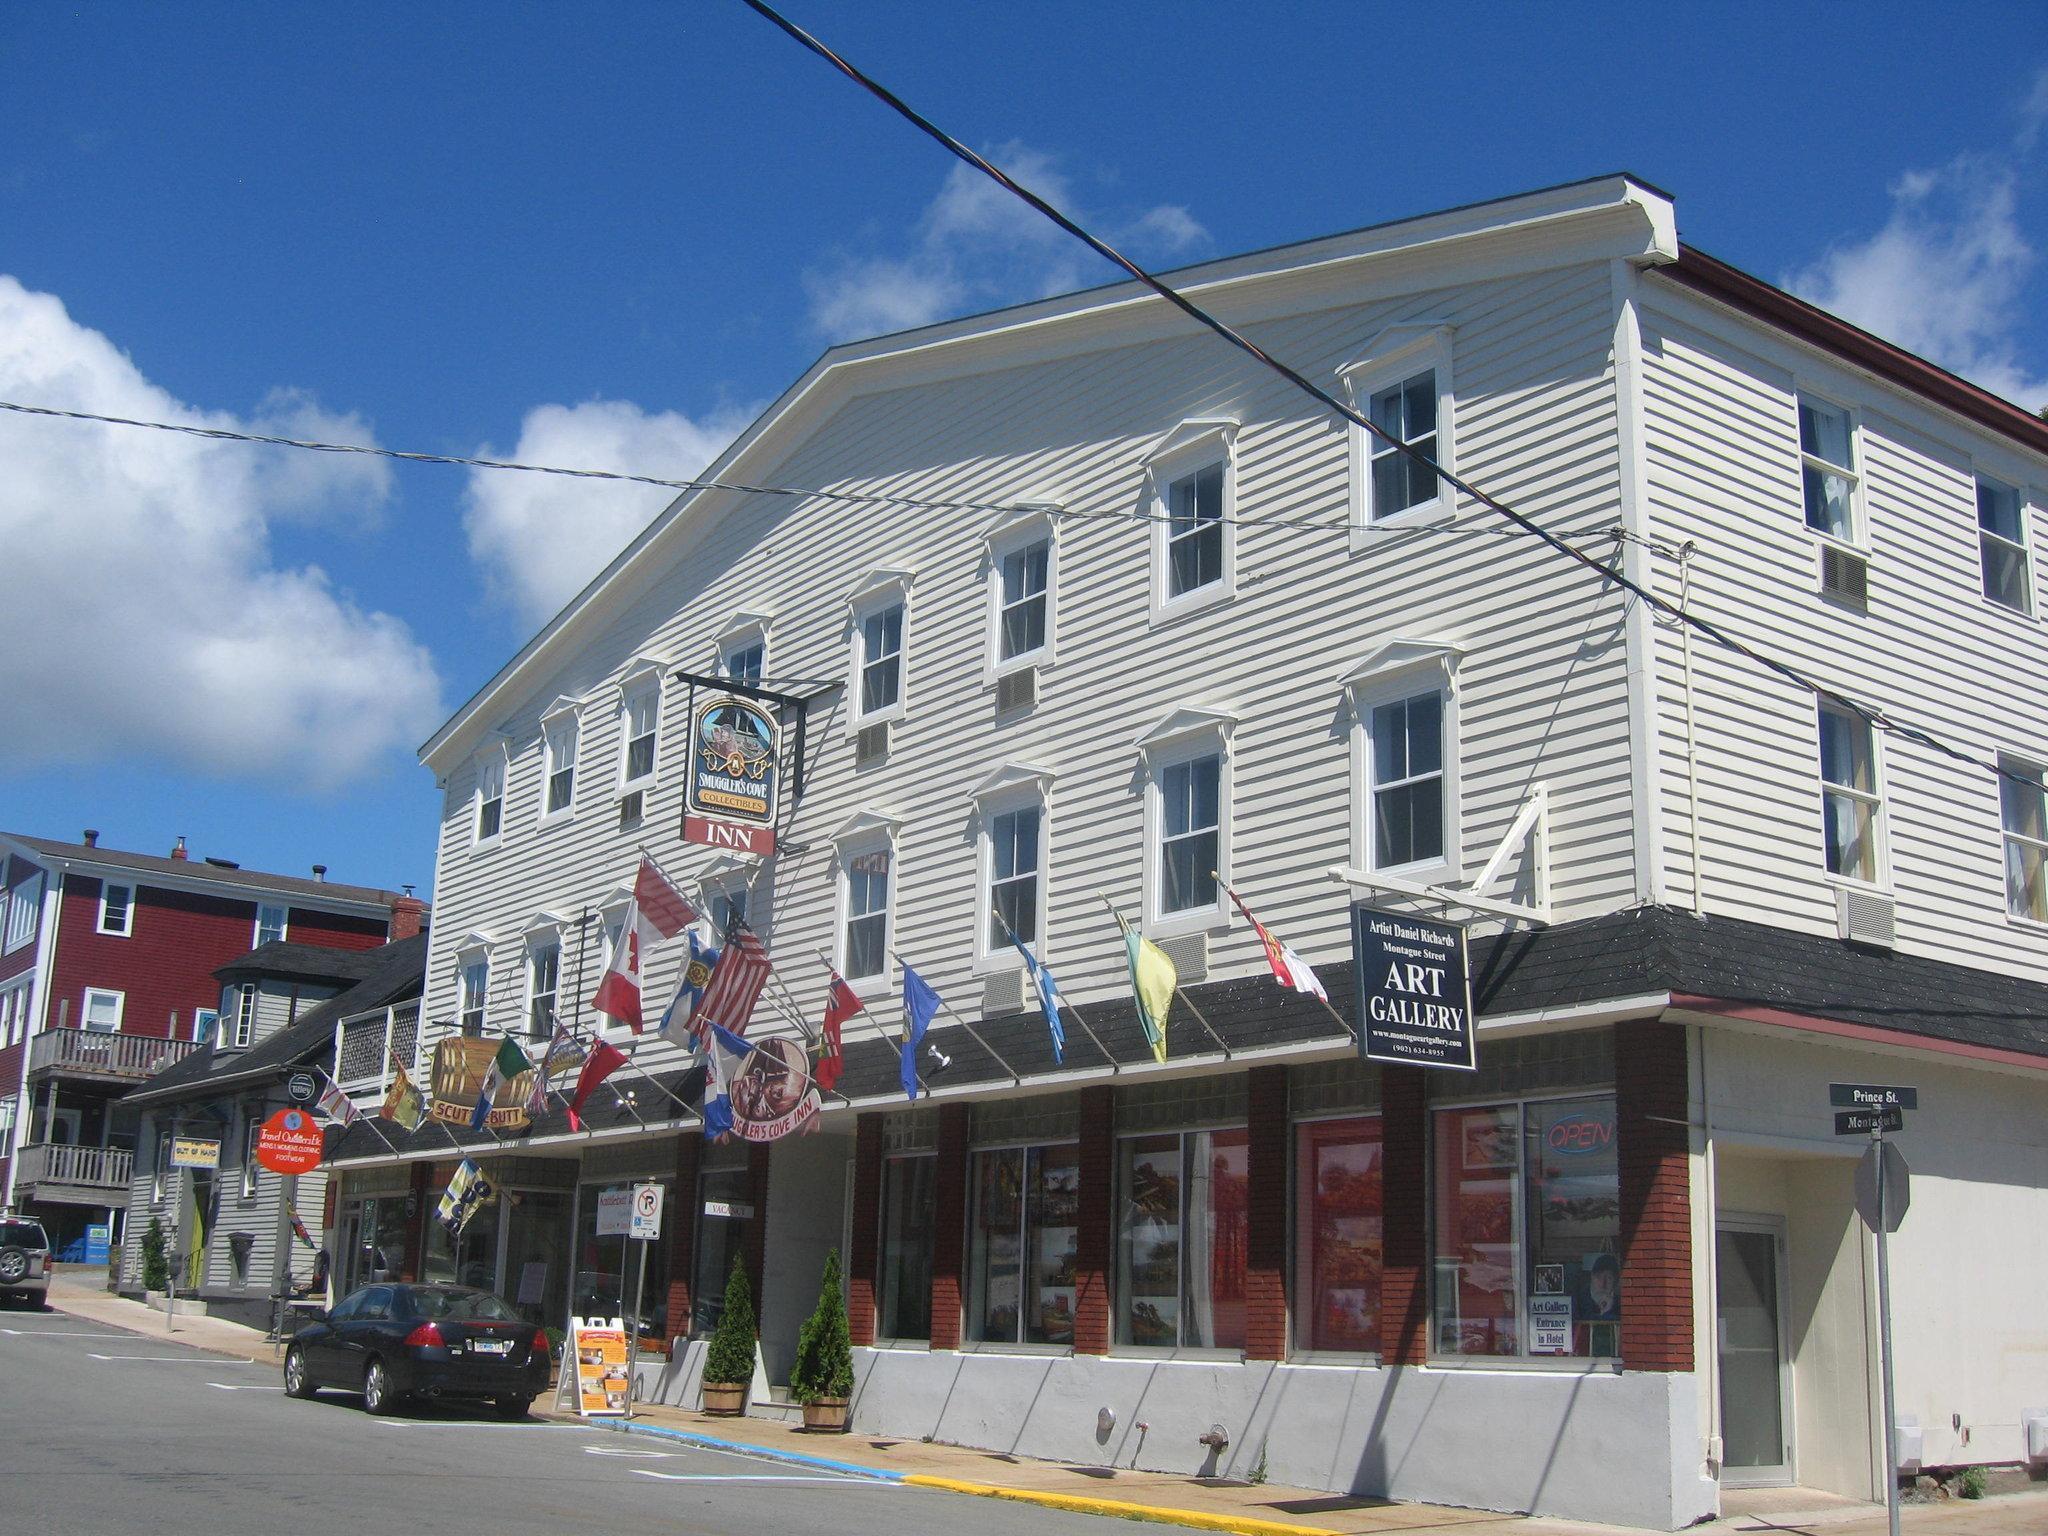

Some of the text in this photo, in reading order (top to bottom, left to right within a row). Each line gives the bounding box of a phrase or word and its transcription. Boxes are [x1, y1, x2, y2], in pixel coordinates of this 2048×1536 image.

[698, 772, 768, 799] SMUGGLER'S COVE
[703, 792, 764, 811] COLLECTIBLES
[705, 823, 753, 850] INN
[1369, 920, 1455, 948] Artist Daniel Richards
[1383, 942, 1446, 962] Montague Street
[1384, 960, 1446, 998] ART
[1370, 995, 1464, 1032] GALLERY
[1392, 1044, 1412, 1054] (902)
[1853, 1089, 1899, 1103] Prince St.
[769, 1118, 791, 1137] COVE
[794, 1099, 813, 1125] INN
[1549, 1121, 1616, 1148] OPEN
[1531, 1301, 1569, 1314] Art Gallery
[1536, 1316, 1566, 1328] Entrance
[1537, 1332, 1565, 1345] in Hotel
